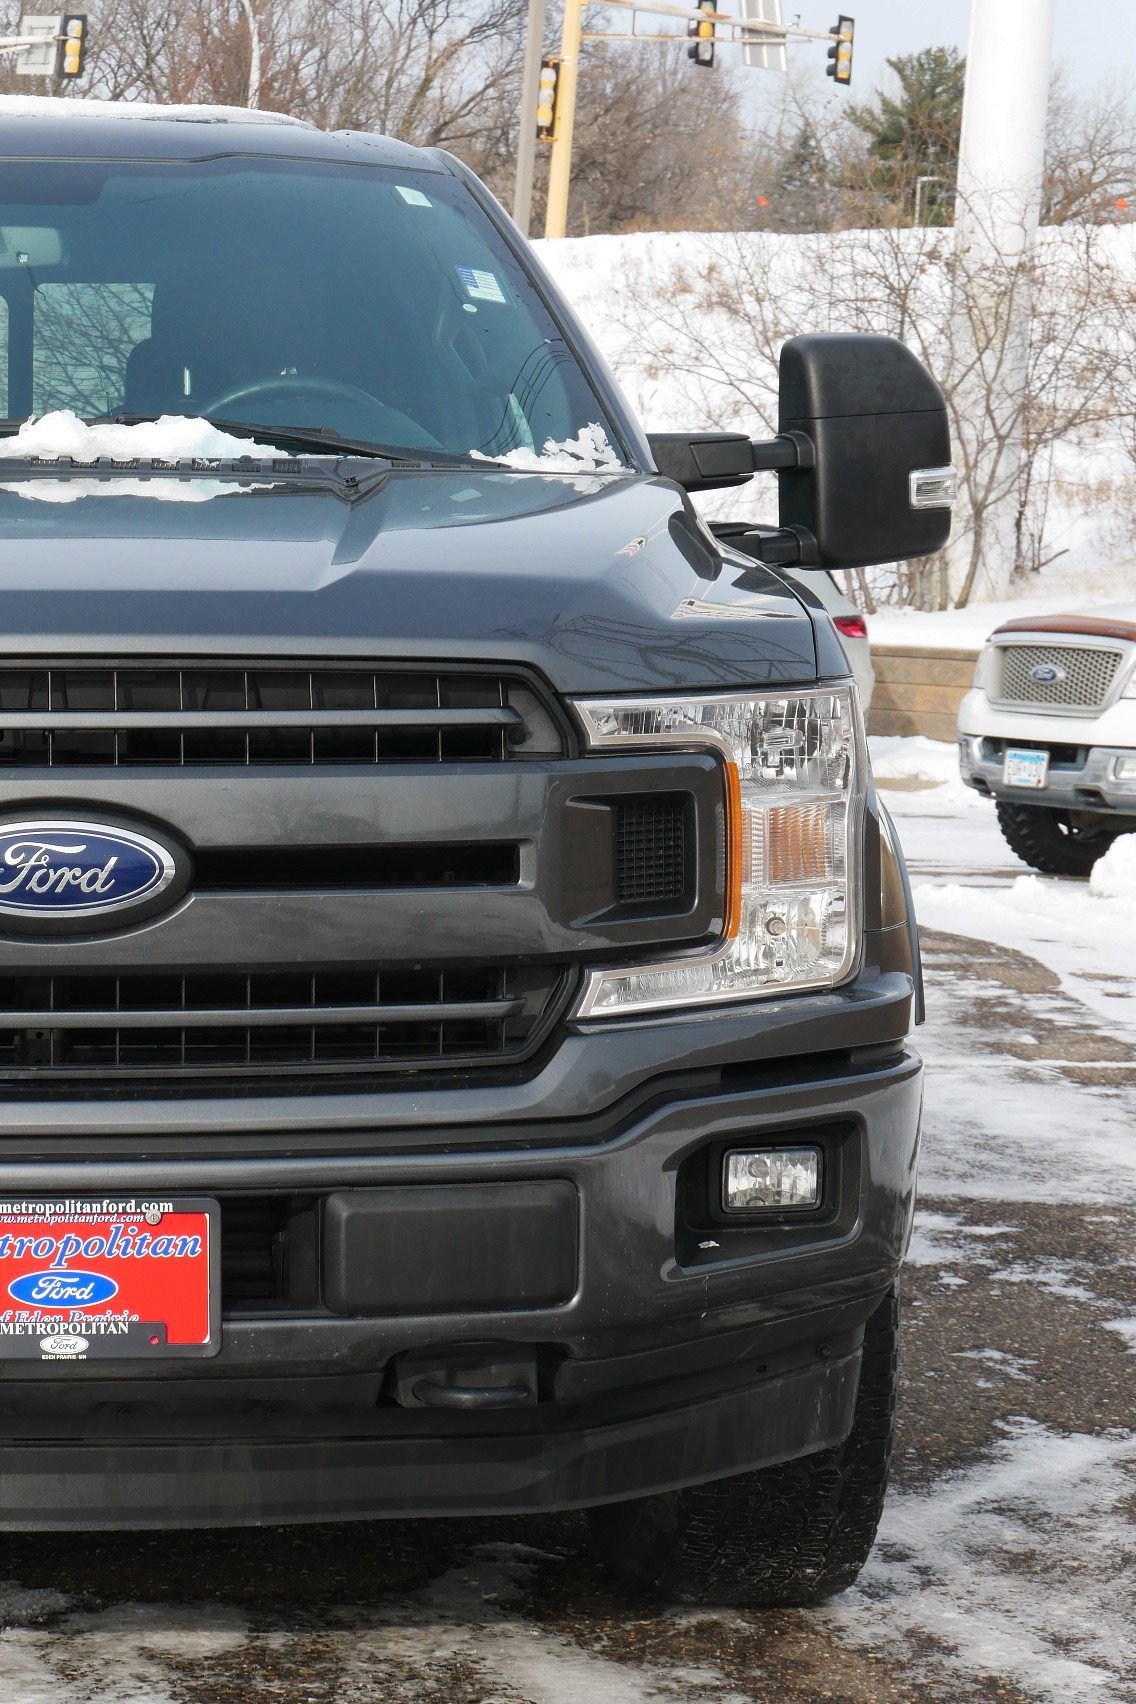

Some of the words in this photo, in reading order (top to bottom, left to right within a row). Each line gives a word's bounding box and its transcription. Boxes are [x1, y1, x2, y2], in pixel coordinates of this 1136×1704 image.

[31, 1275, 95, 1300] Ford
[0, 1321, 129, 1335] METROPOLITAN
[50, 1338, 78, 1351] Ford
